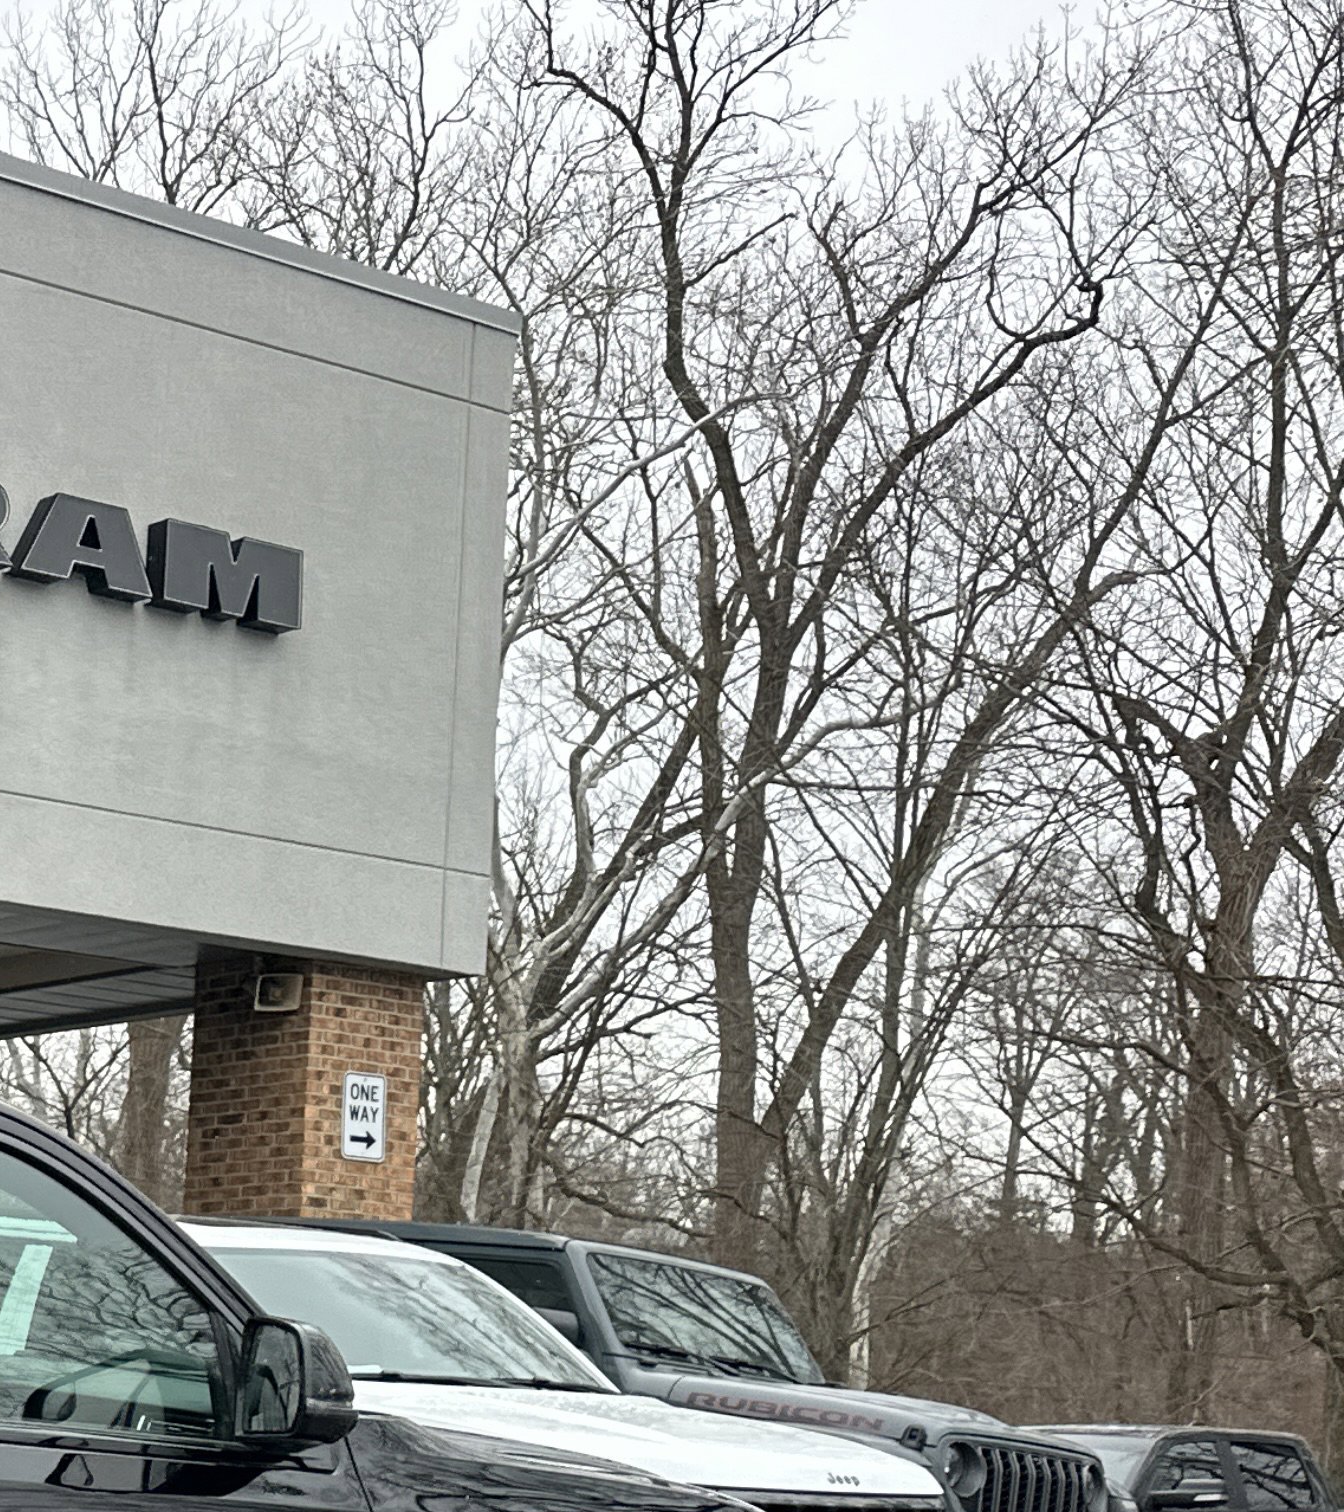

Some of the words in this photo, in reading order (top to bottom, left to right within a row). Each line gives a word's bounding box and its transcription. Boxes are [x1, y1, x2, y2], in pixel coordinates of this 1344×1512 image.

[350, 1083, 379, 1102] ONE
[349, 1104, 379, 1123] WAY
[686, 1391, 885, 1432] RUBICON
